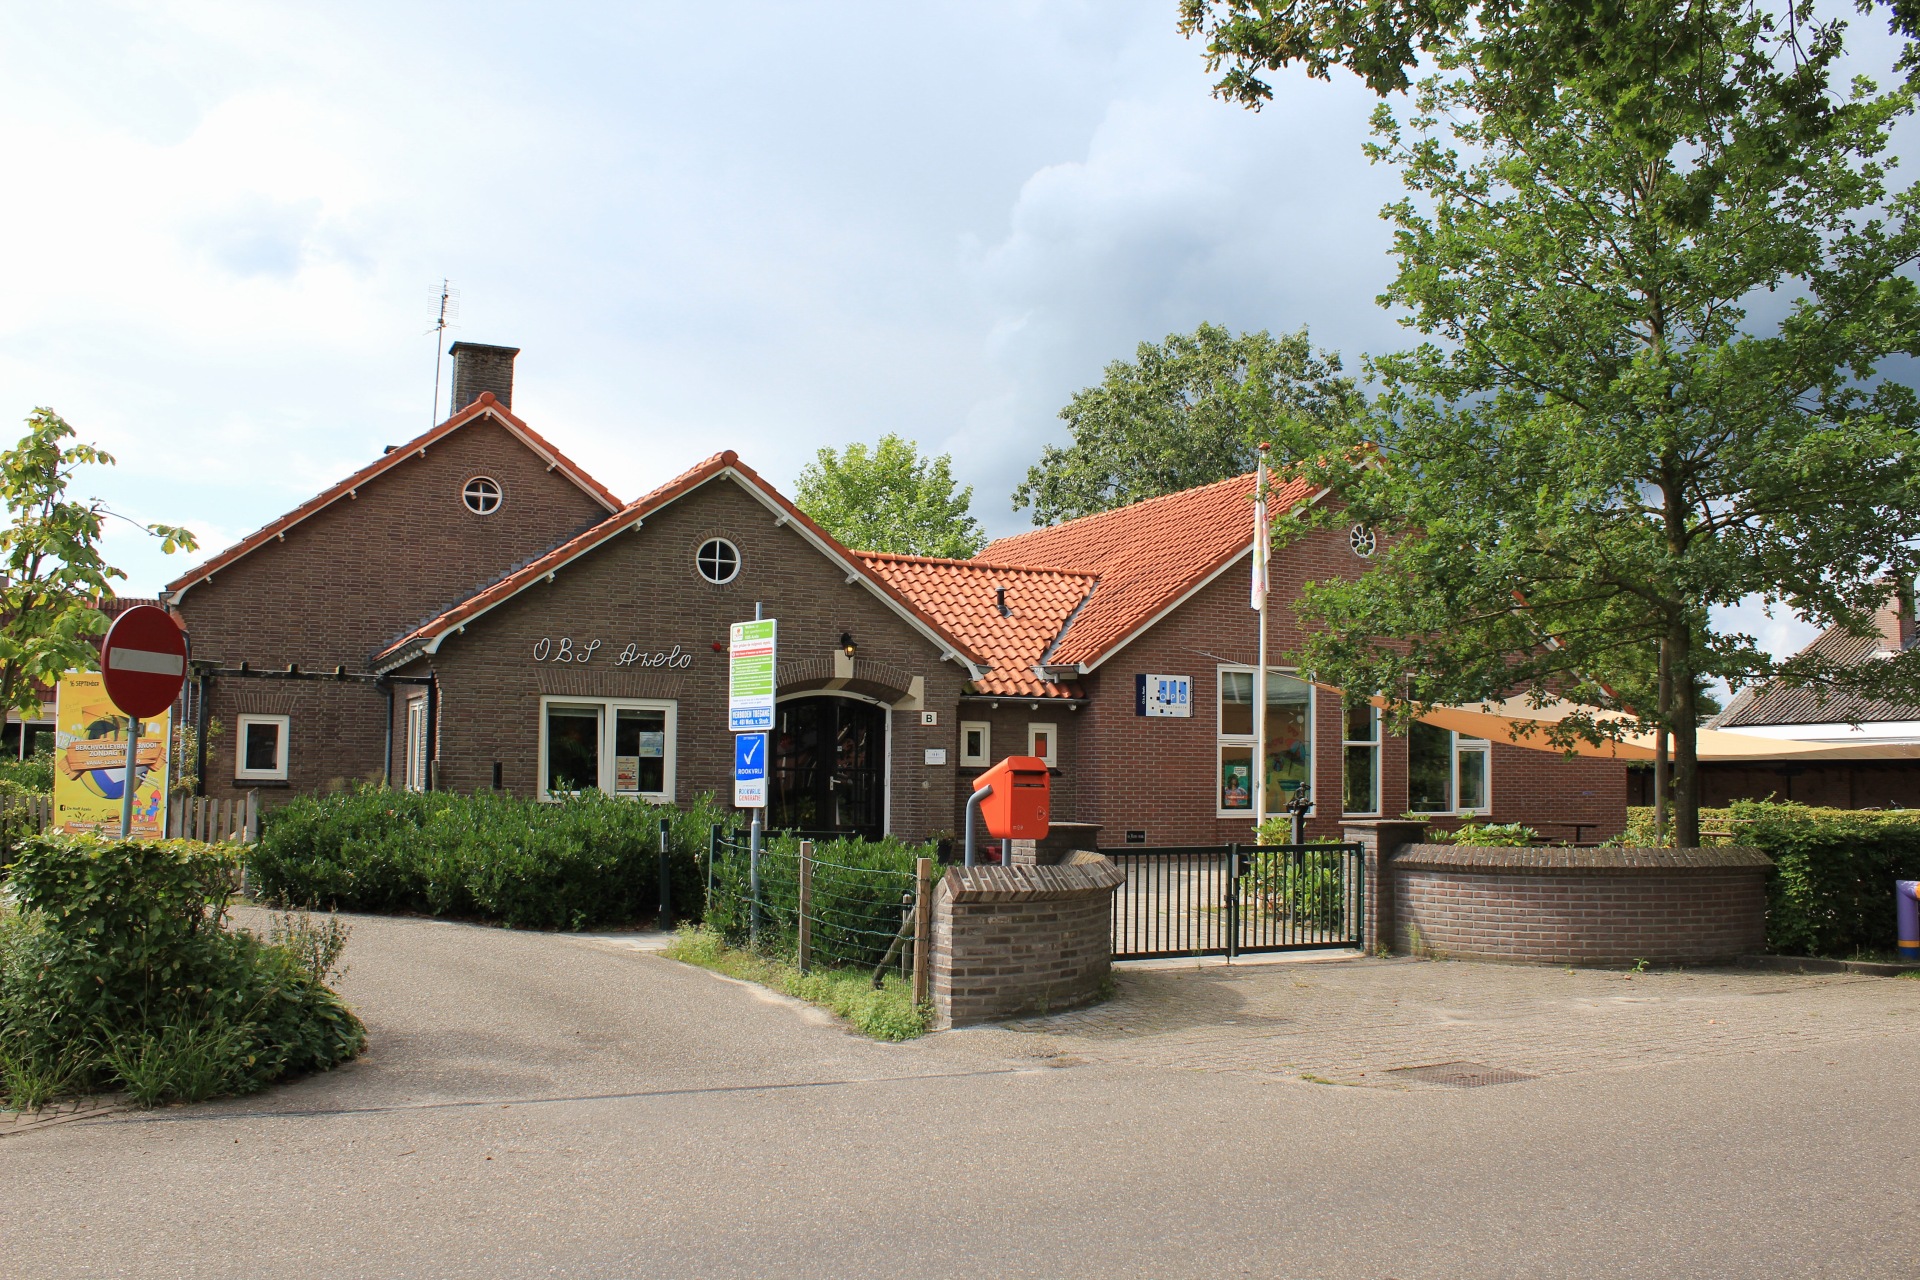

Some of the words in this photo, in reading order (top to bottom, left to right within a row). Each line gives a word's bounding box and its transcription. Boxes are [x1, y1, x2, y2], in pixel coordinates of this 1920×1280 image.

[533, 637, 601, 663] OBS
[614, 642, 692, 669] Azelo
[732, 710, 753, 719] VERBODEN
[752, 708, 770, 717] TOEGANG
[926, 714, 933, 723] B
[89, 749, 118, 757] ZONDAG
